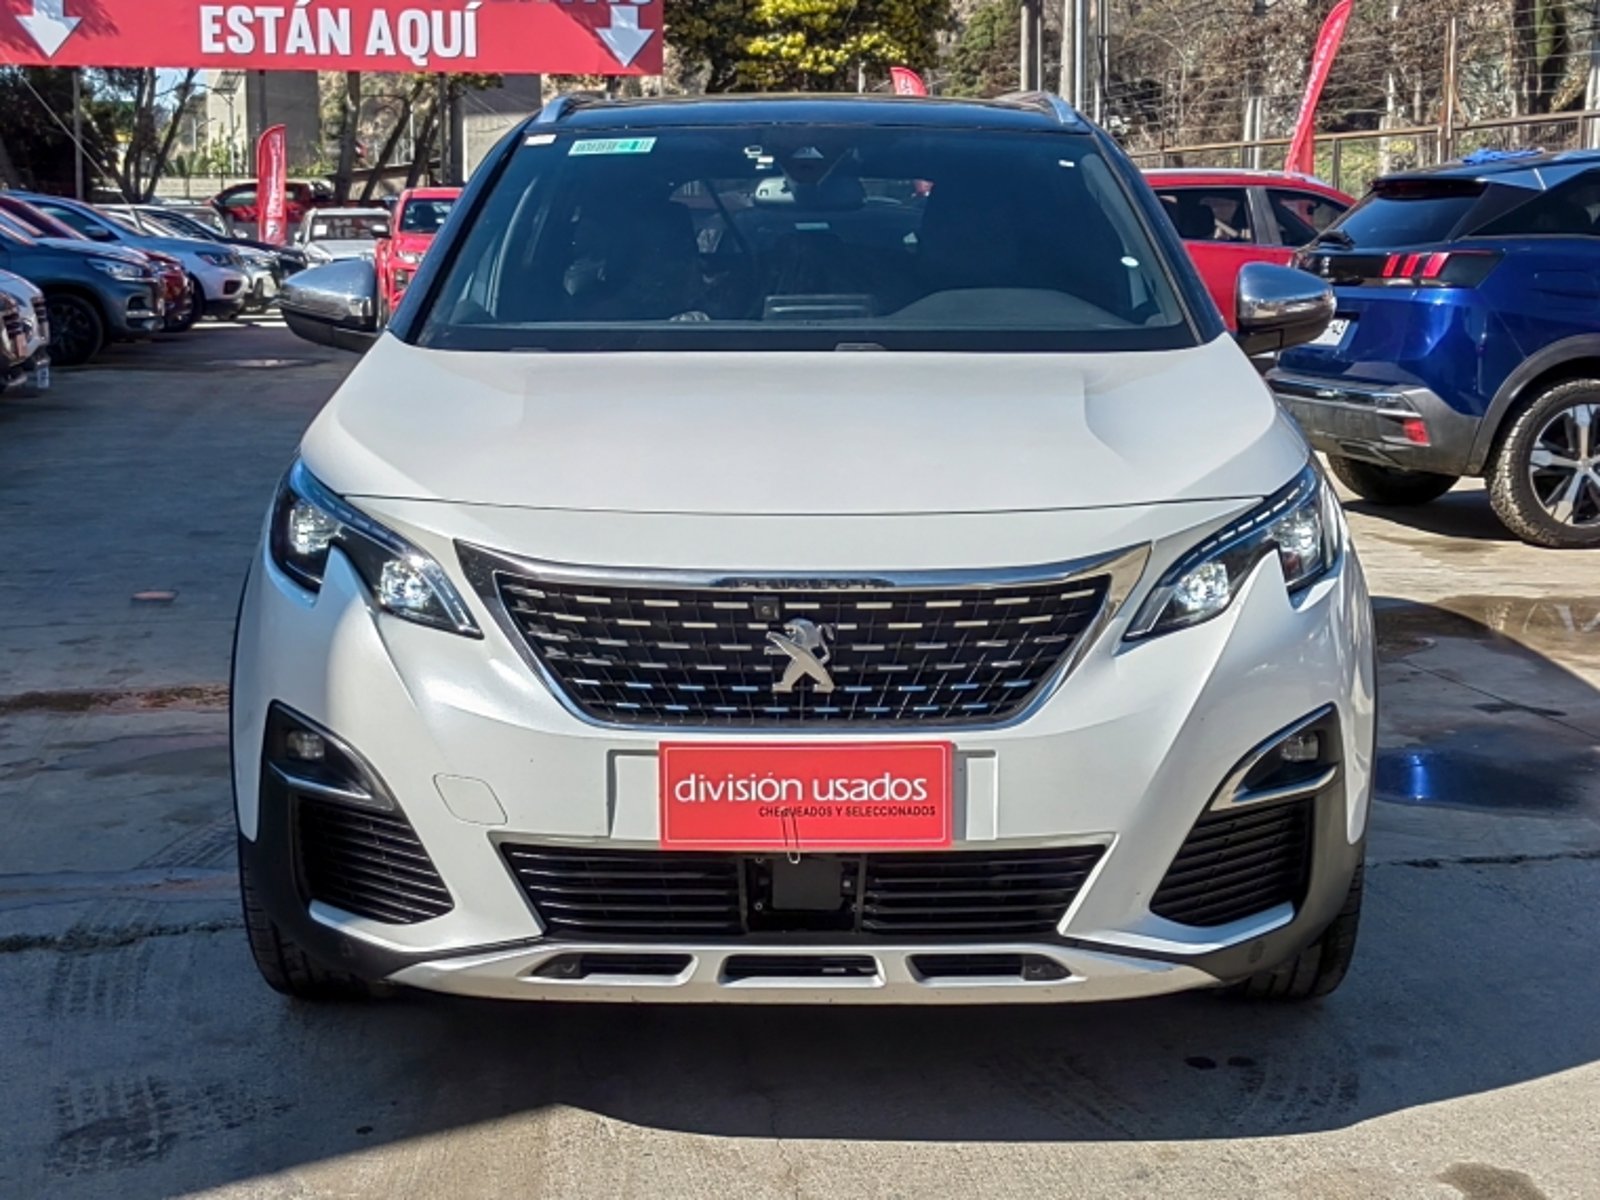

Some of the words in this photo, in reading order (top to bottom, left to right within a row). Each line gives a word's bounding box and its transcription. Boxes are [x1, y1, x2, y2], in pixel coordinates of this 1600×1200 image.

[200, 0, 352, 55] ESTÁN
[365, 2, 482, 66] AQUÍ
[674, 772, 802, 803] división
[812, 772, 927, 801] usados
[835, 805, 842, 816] Y
[845, 805, 936, 817] SELECCIONADOS
